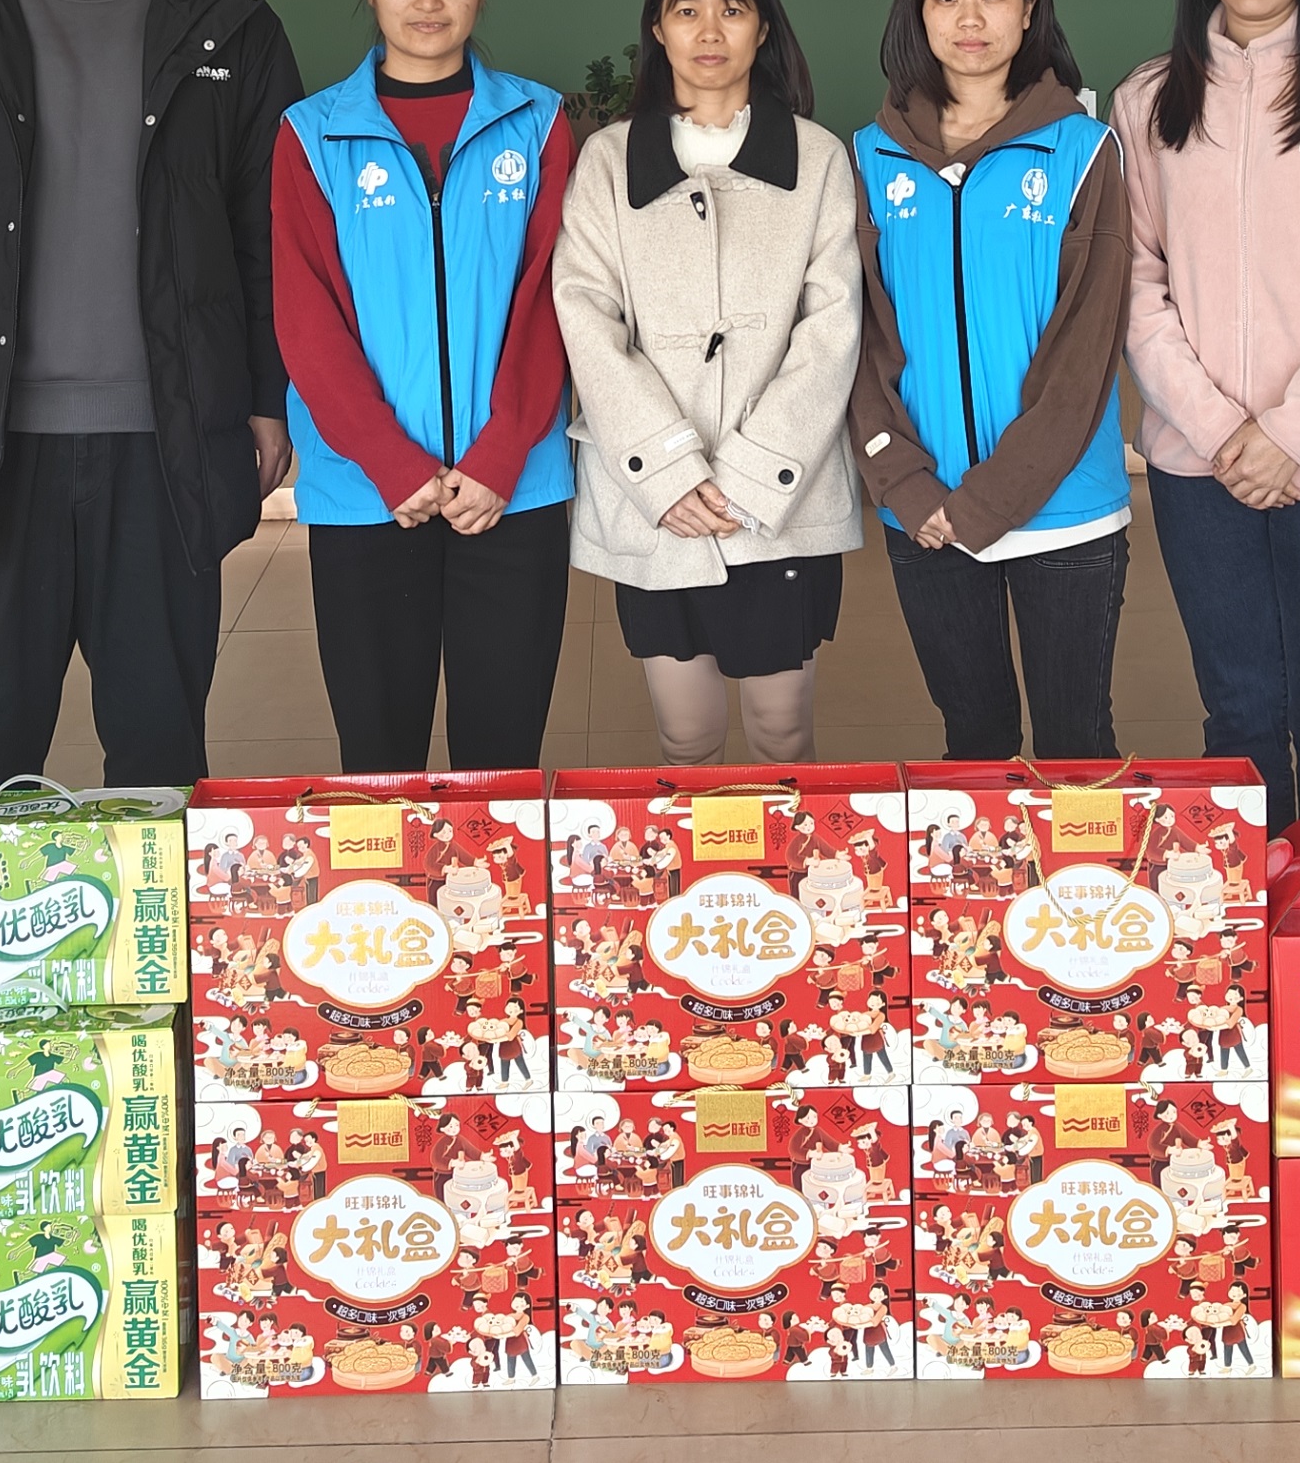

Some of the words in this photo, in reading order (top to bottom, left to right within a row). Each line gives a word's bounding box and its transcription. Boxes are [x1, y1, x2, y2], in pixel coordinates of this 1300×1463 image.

[728, 830, 759, 845] 旺通
[1086, 822, 1118, 836] 旺通
[366, 837, 397, 853] 旺通
[141, 828, 157, 884] 喝优酸乳
[699, 892, 761, 907] 旺事锦礼
[1058, 885, 1119, 899] 旺事锦礼
[664, 909, 796, 960] 大礼盒
[1022, 902, 1155, 953] 大礼盒
[133, 888, 170, 995] 赢黄金
[302, 917, 435, 969] 大礼盒
[29, 958, 96, 1003] 乳饮料
[691, 999, 775, 1021] 超多口味一次享受
[1049, 993, 1132, 1013] 超多口味一次享受
[328, 1007, 412, 1028] 超多口味一次享受
[132, 1035, 148, 1092] 喝优酸乳
[730, 1122, 761, 1137] 旺通
[1090, 1117, 1121, 1132] 旺通
[122, 1095, 161, 1205] 赢黄金
[372, 1133, 404, 1148] 旺通
[15, 1169, 84, 1216] 乳饮料
[703, 1184, 764, 1199] 旺事锦礼
[1061, 1181, 1123, 1196] 旺事锦礼
[344, 1195, 406, 1210] 旺事锦礼
[667, 1201, 799, 1252] 大礼盒
[1025, 1198, 1159, 1249] 大礼盒
[132, 1219, 148, 1275] 喝优酸乳
[309, 1211, 442, 1263] 大礼盒
[694, 1291, 778, 1312] 超多口味一次享受
[1052, 1289, 1136, 1310] 超多口味一次享受
[335, 1303, 419, 1324] 超多口味一次享受
[122, 1279, 160, 1390] 赢黄金
[16, 1351, 84, 1397] 乳饮料
